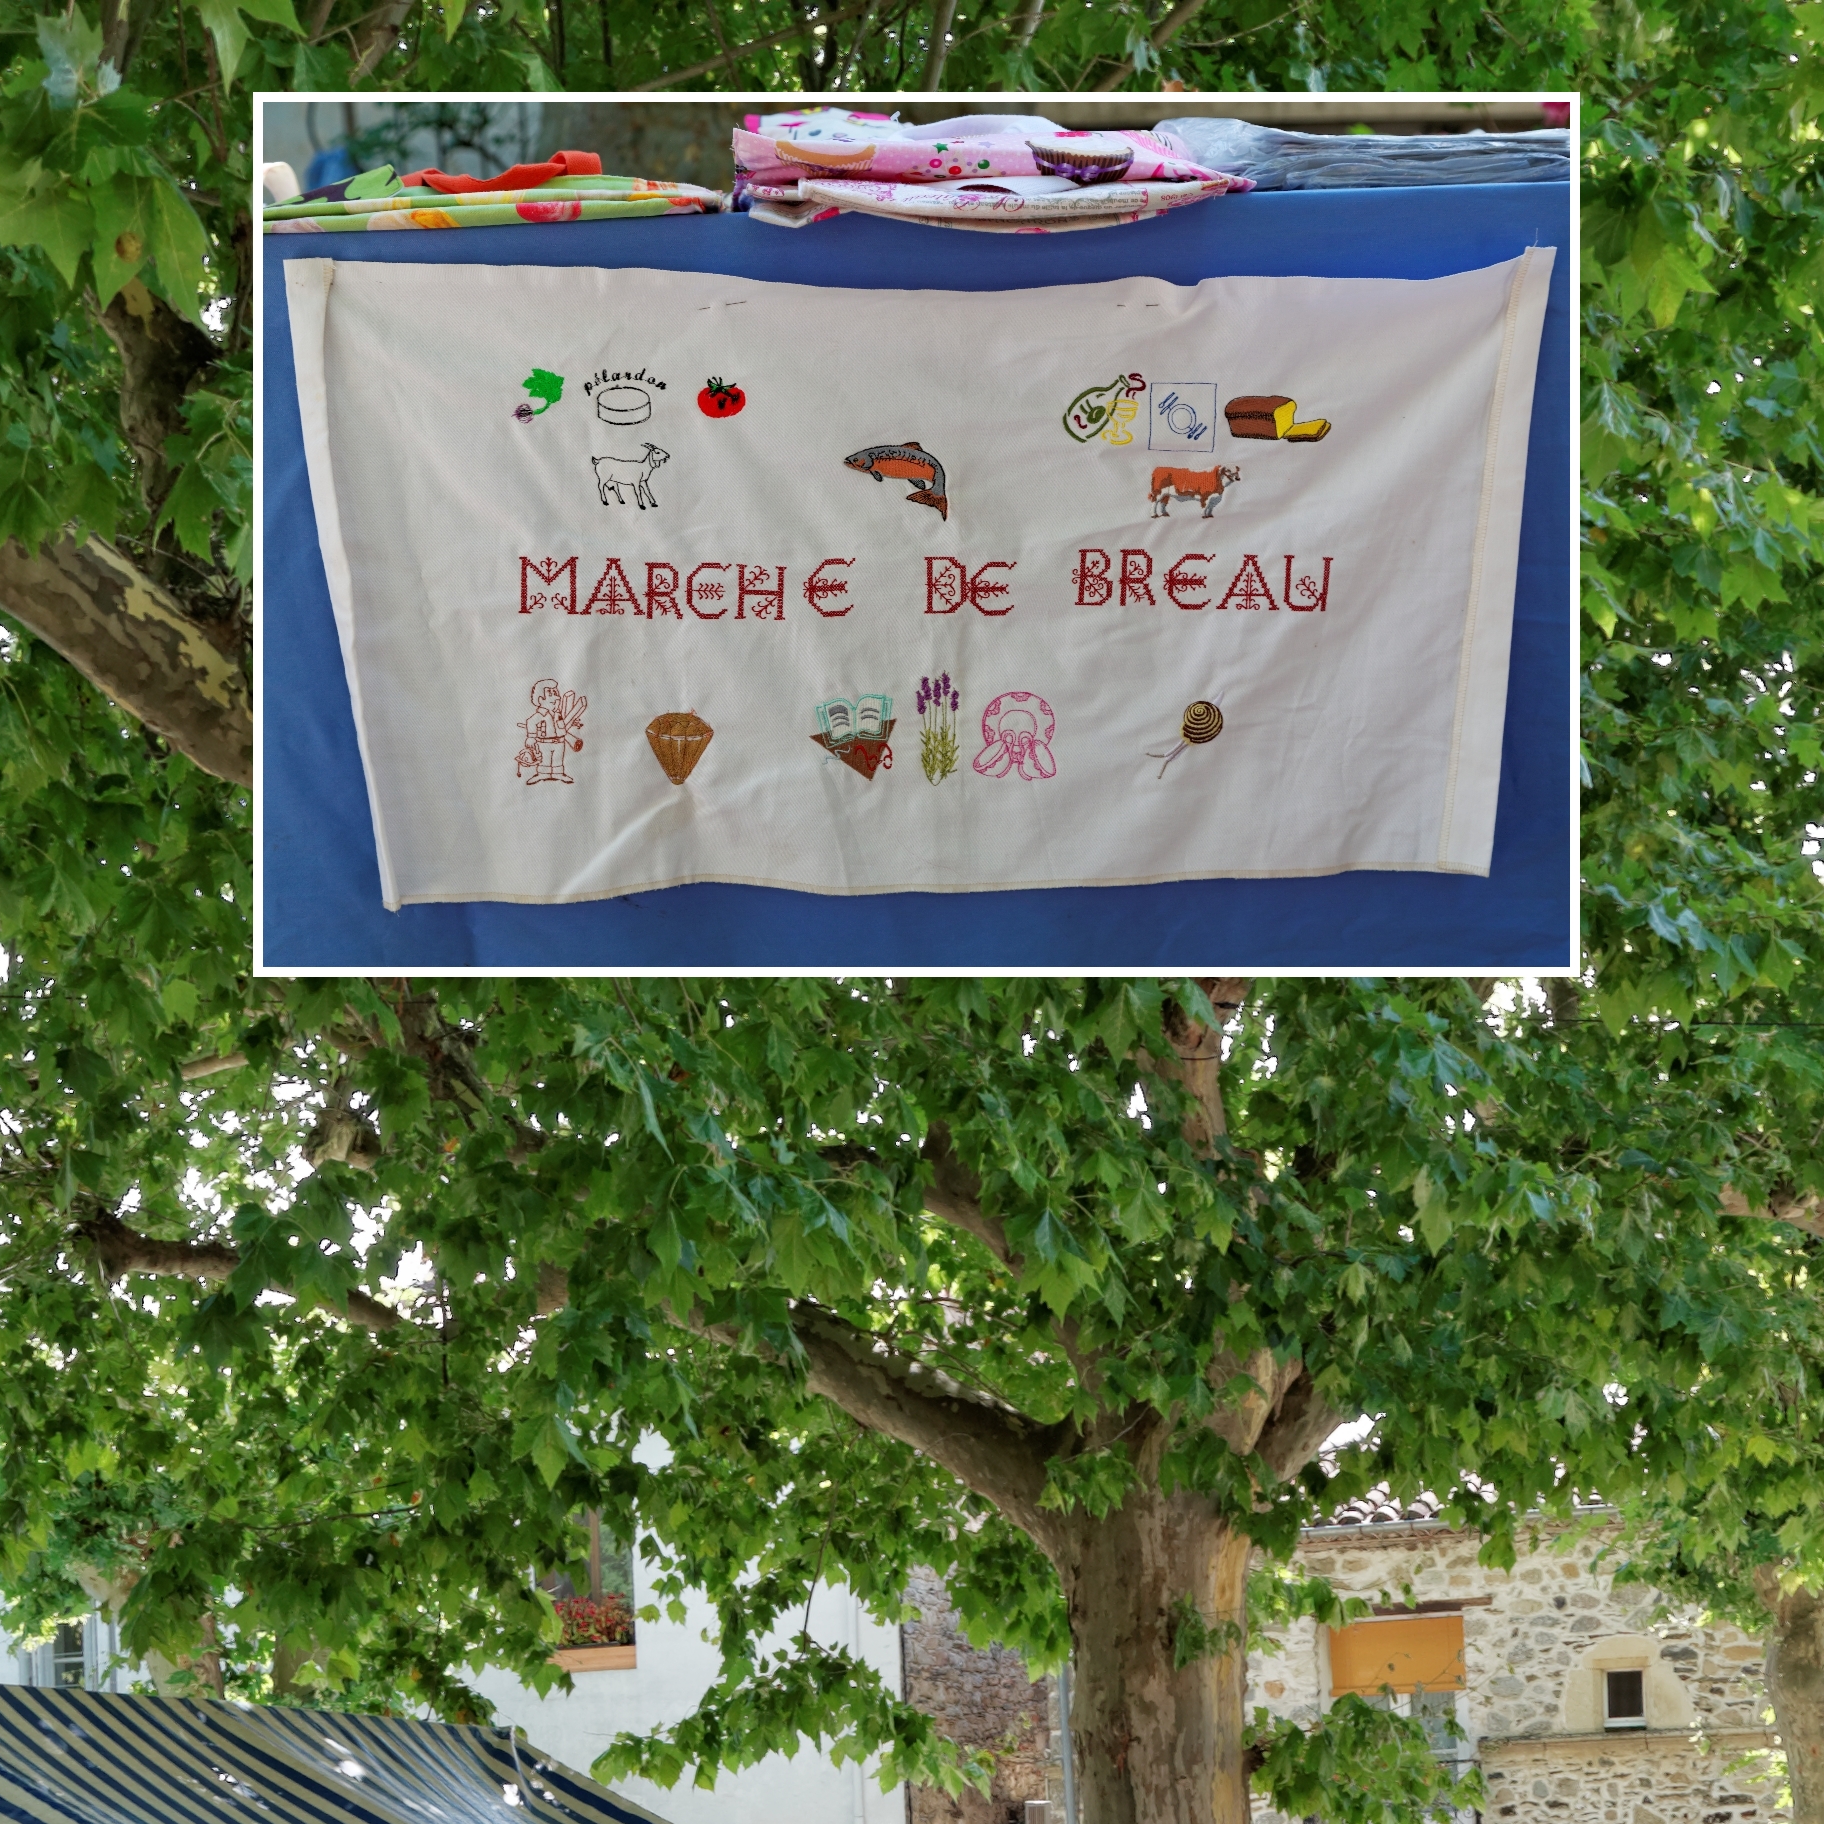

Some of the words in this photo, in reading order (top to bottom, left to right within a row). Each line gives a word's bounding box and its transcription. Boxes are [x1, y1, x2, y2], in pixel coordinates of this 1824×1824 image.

[518, 556, 856, 620] MARCHE
[924, 556, 1017, 616] DE
[1072, 548, 1334, 612] BREAU
